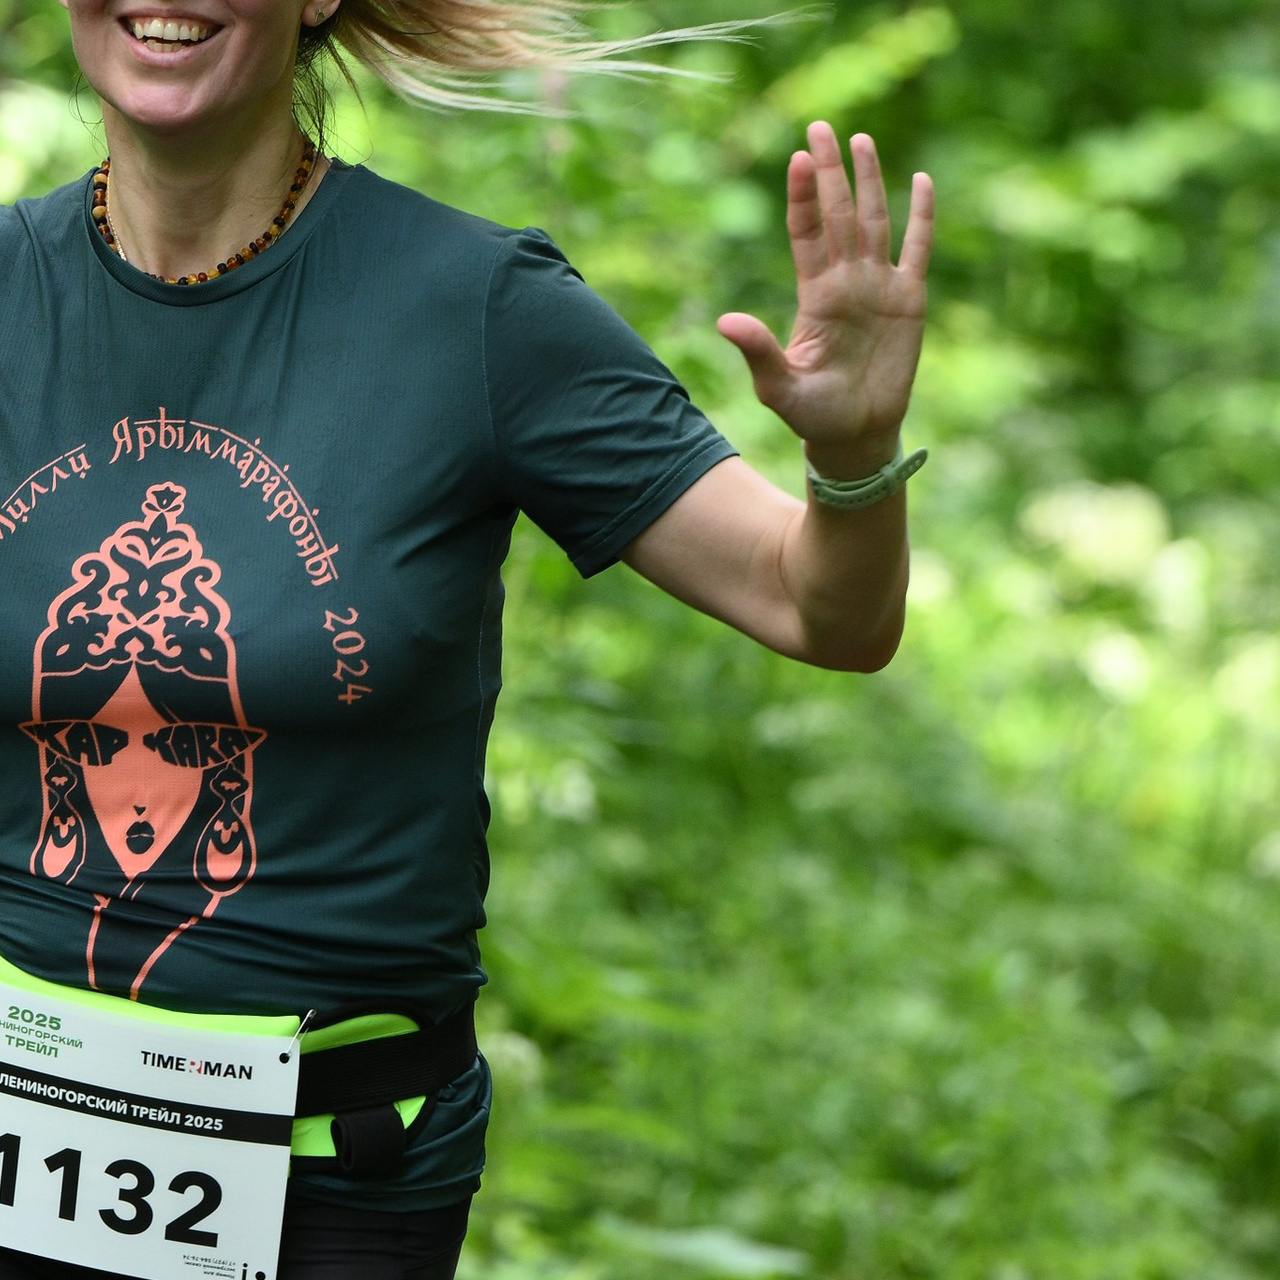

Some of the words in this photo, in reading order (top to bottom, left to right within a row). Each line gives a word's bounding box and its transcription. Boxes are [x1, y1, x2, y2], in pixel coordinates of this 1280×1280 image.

[323, 607, 373, 705] 2024
[7, 1005, 62, 1031] 2025
[4, 1034, 59, 1058] ТРЕЙЛ
[130, 1104, 181, 1124] ТРЕЙЛ
[183, 1113, 224, 1131] 2025
